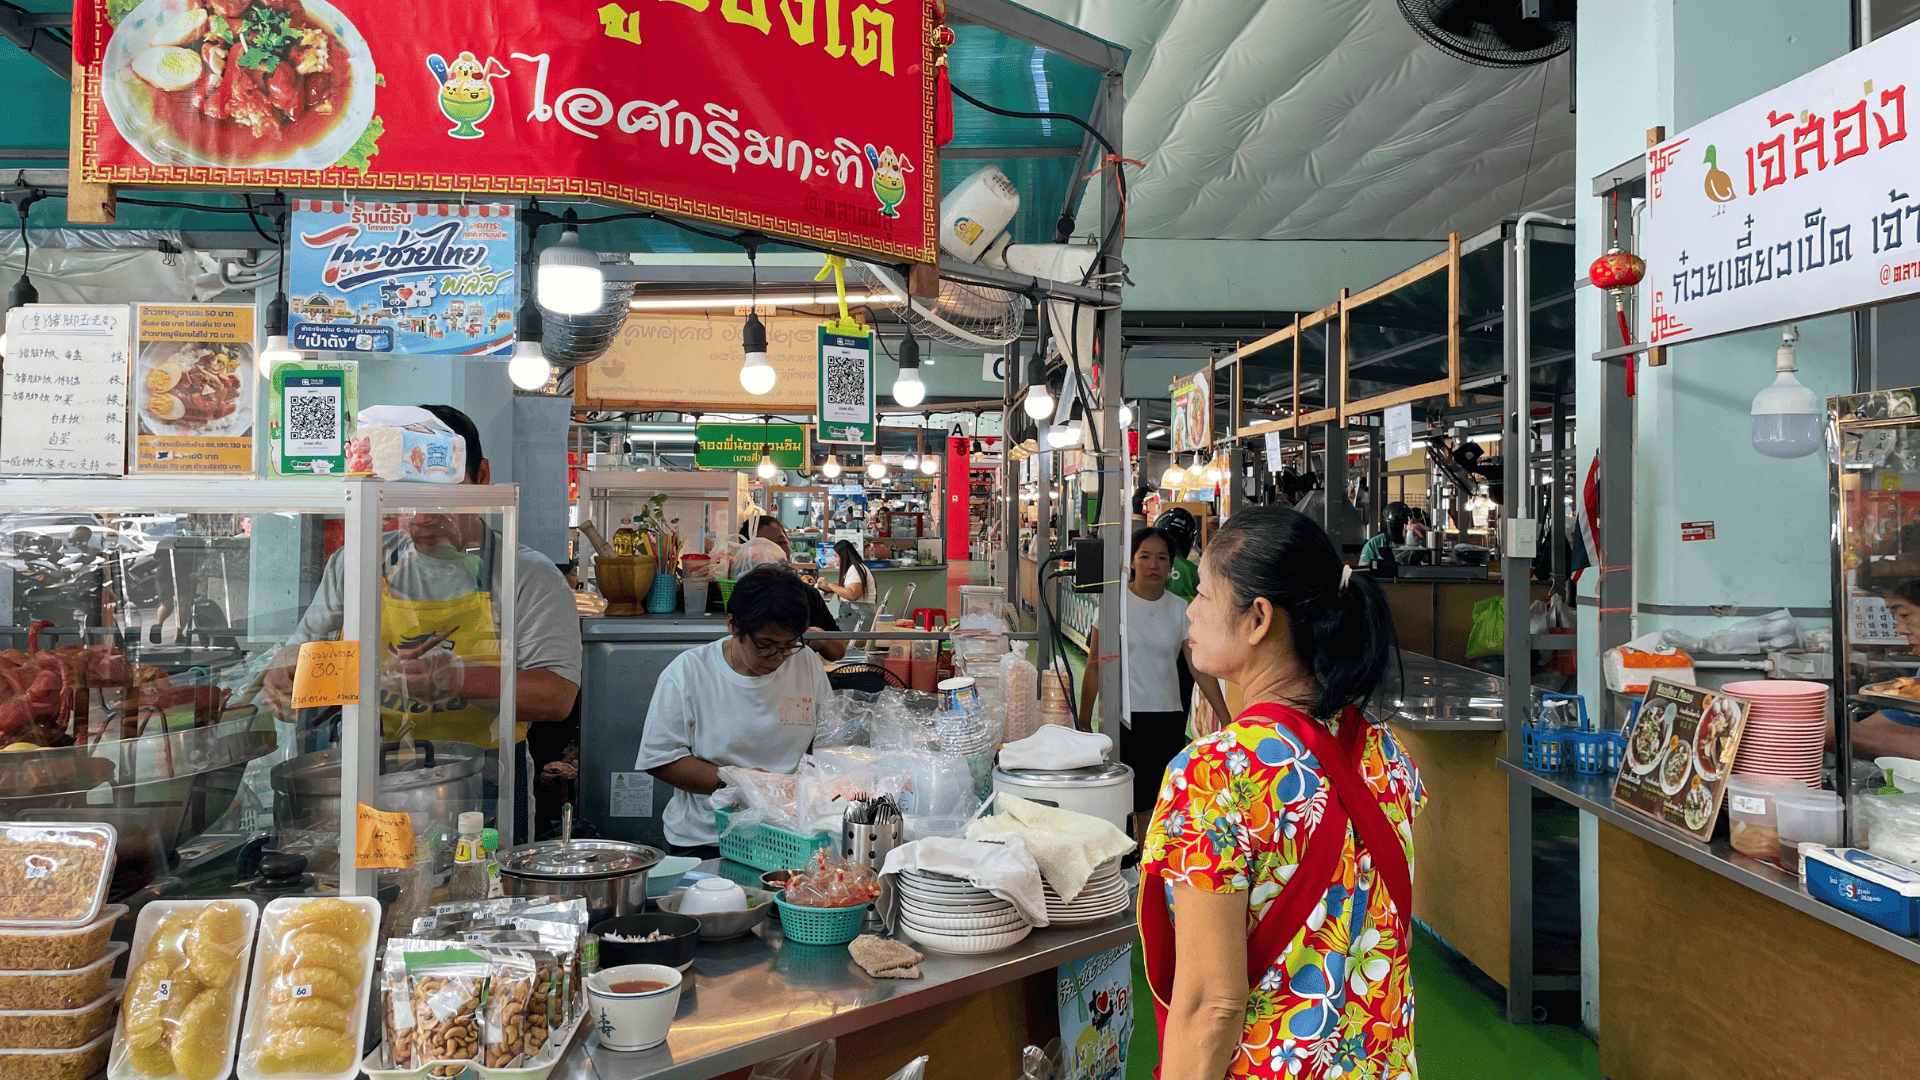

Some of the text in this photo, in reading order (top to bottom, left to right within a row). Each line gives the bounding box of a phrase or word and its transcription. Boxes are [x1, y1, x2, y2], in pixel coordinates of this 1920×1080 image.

[511, 53, 863, 188] ไอศกรีมกะทิ
[352, 204, 412, 225] ร้านนี้รับ
[302, 221, 485, 284] ไทยช่วยไทย
[1673, 207, 1853, 304] ก๋วยเตี๋ยวเป็ด
[441, 265, 513, 296] พลัส
[143, 307, 204, 318] ข้าวขาหมูจานละ
[951, 423, 964, 436] A
[295, 986, 307, 996] 60
